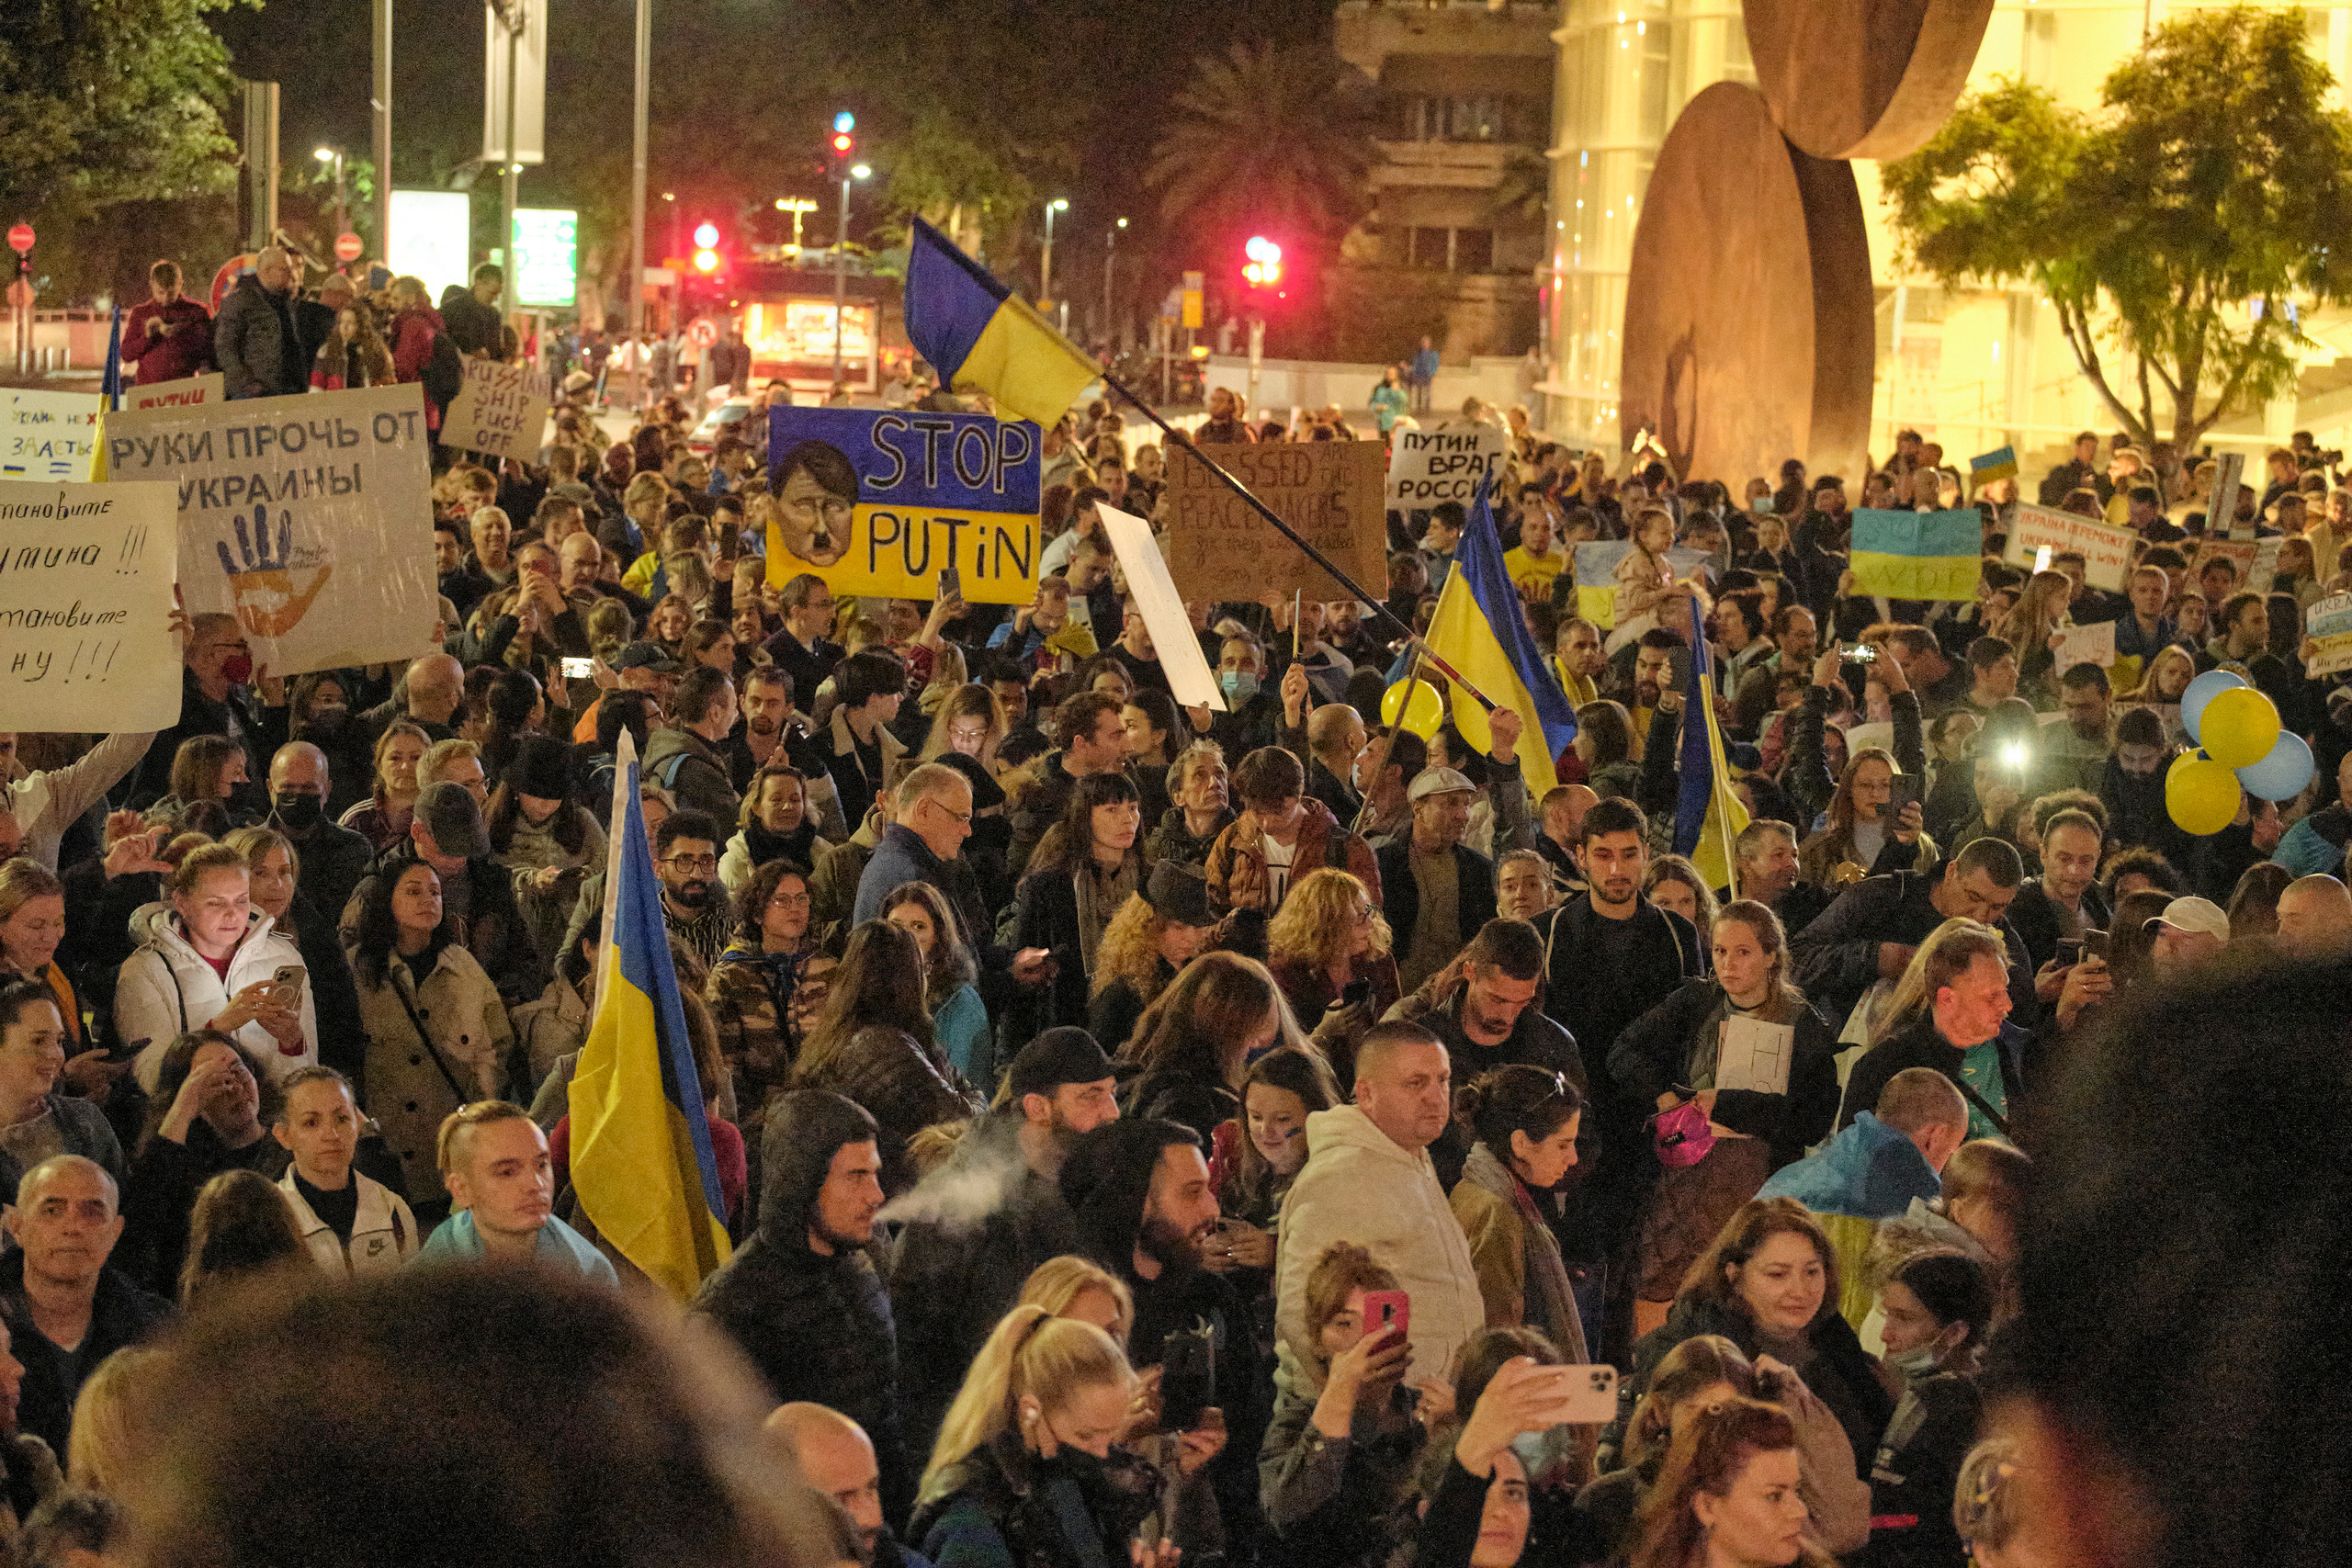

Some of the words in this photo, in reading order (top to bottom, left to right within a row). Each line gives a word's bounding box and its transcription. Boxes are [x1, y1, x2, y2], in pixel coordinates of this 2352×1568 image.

[474, 384, 530, 413] SHIP
[111, 430, 215, 470] РУКИ
[227, 418, 360, 460] ПРОЧЬ
[372, 411, 419, 444] ОТ
[476, 429, 514, 452] OFF
[865, 414, 1032, 494] STOP
[1404, 433, 1478, 452] ПУТИН
[1429, 453, 1501, 475] ВРАГ
[177, 463, 362, 511] УКРАИНЫ
